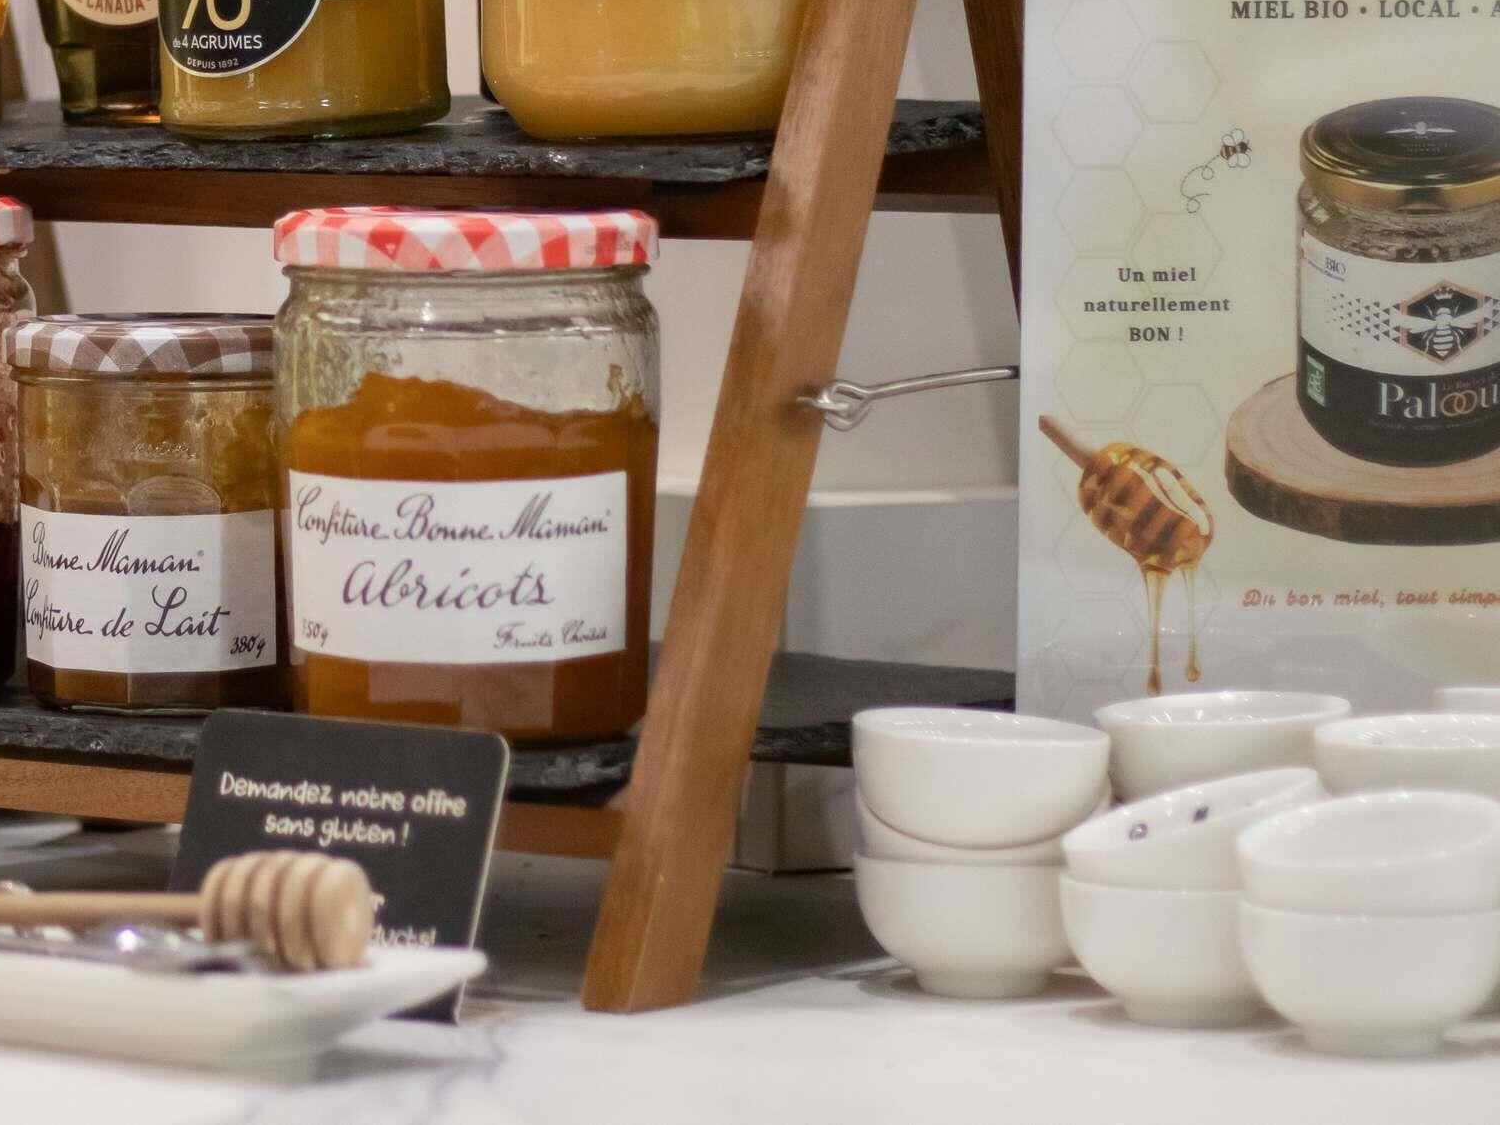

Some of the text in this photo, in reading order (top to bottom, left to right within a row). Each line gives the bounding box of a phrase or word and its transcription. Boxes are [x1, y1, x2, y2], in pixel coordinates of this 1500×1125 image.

[1231, 0, 1294, 20] MIEL
[1304, 0, 1350, 19] BIO
[1379, 0, 1460, 19] LOCAL
[191, 34, 263, 50] AGRUMES
[187, 56, 239, 70] DEPUIS 1892
[1118, 266, 1197, 283] Un miel
[1083, 298, 1230, 312] naturellement
[1129, 327, 1170, 342] BON
[296, 485, 609, 545] Confiture Bonne Maman
[32, 521, 200, 575] Bonne Maman
[1286, 589, 1324, 607] bon
[1396, 589, 1439, 606] tout
[26, 577, 231, 640] Confiture de Lait
[493, 621, 553, 651] Fruits
[562, 619, 607, 645] Choisis
[220, 771, 467, 818] Demandez notre offre
[264, 813, 315, 838] sans
[318, 818, 395, 847] gluten
